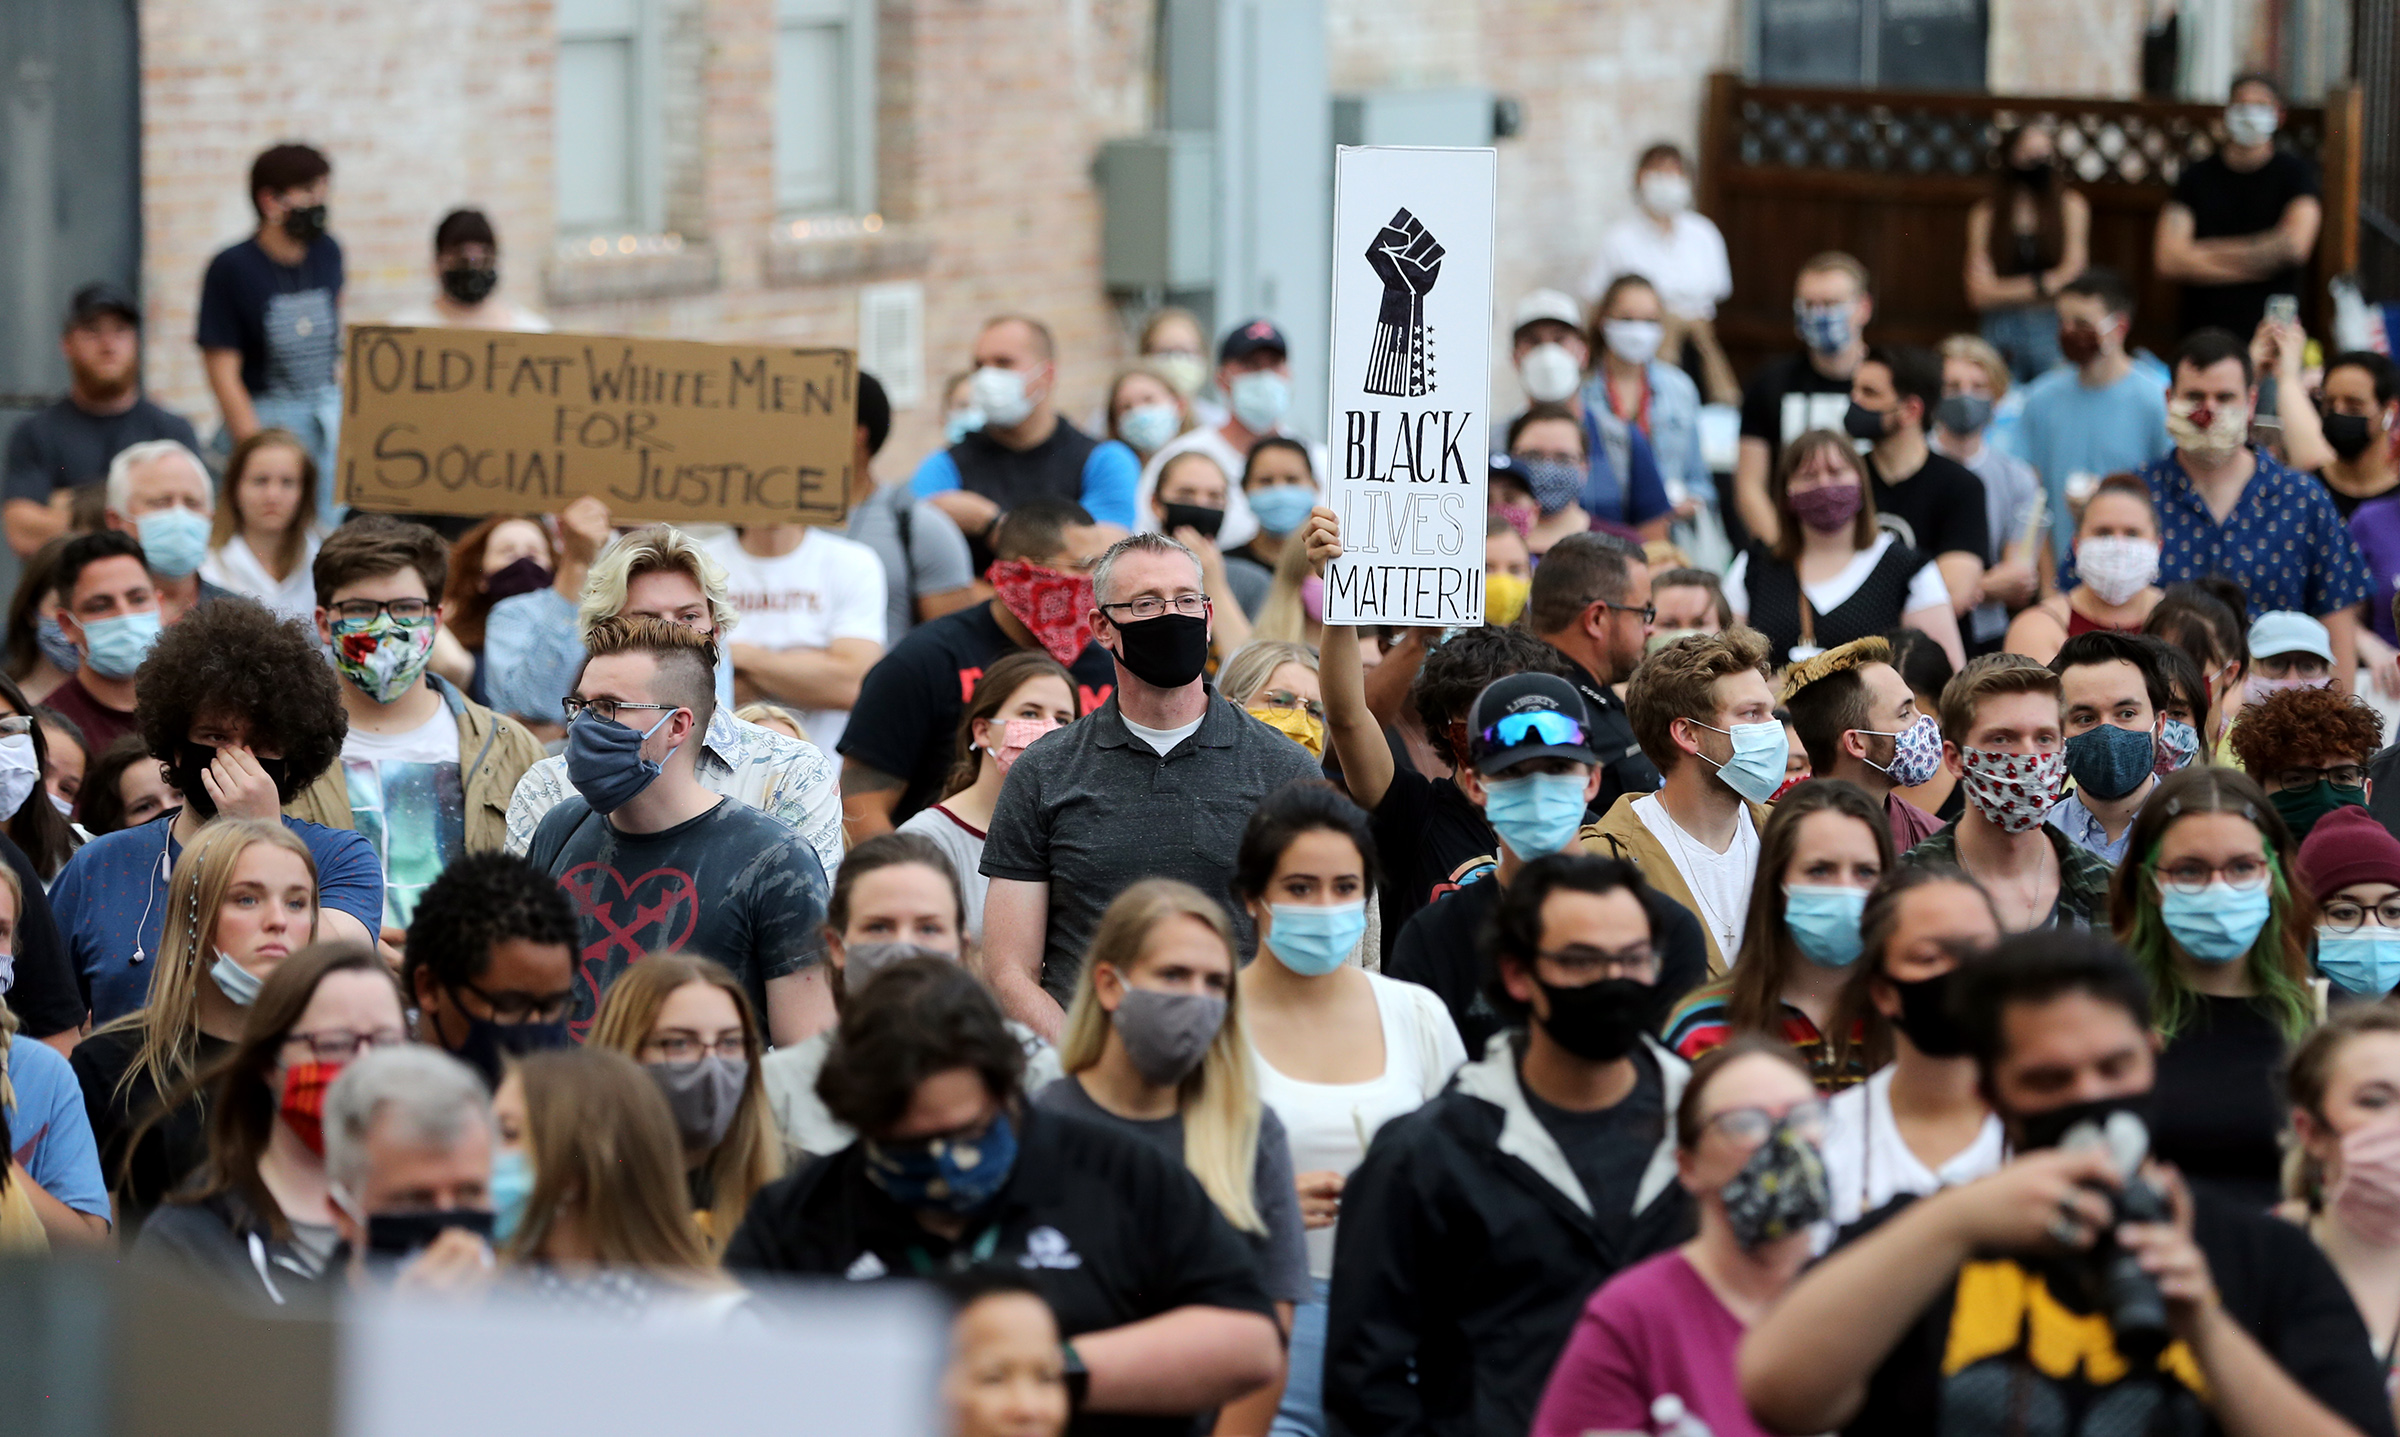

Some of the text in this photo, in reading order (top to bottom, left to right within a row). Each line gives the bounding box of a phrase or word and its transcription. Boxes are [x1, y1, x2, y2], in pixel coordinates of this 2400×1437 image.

[367, 337, 834, 416] OLD FAT WHITE MEN
[555, 405, 676, 453] FOR
[1344, 410, 1473, 485] BLACK
[372, 421, 838, 511] SOCIAL JUSTICE
[1343, 489, 1465, 556] LIVES
[1328, 563, 1480, 621] MATTER!!
[1506, 694, 1560, 714] LIBERTY
